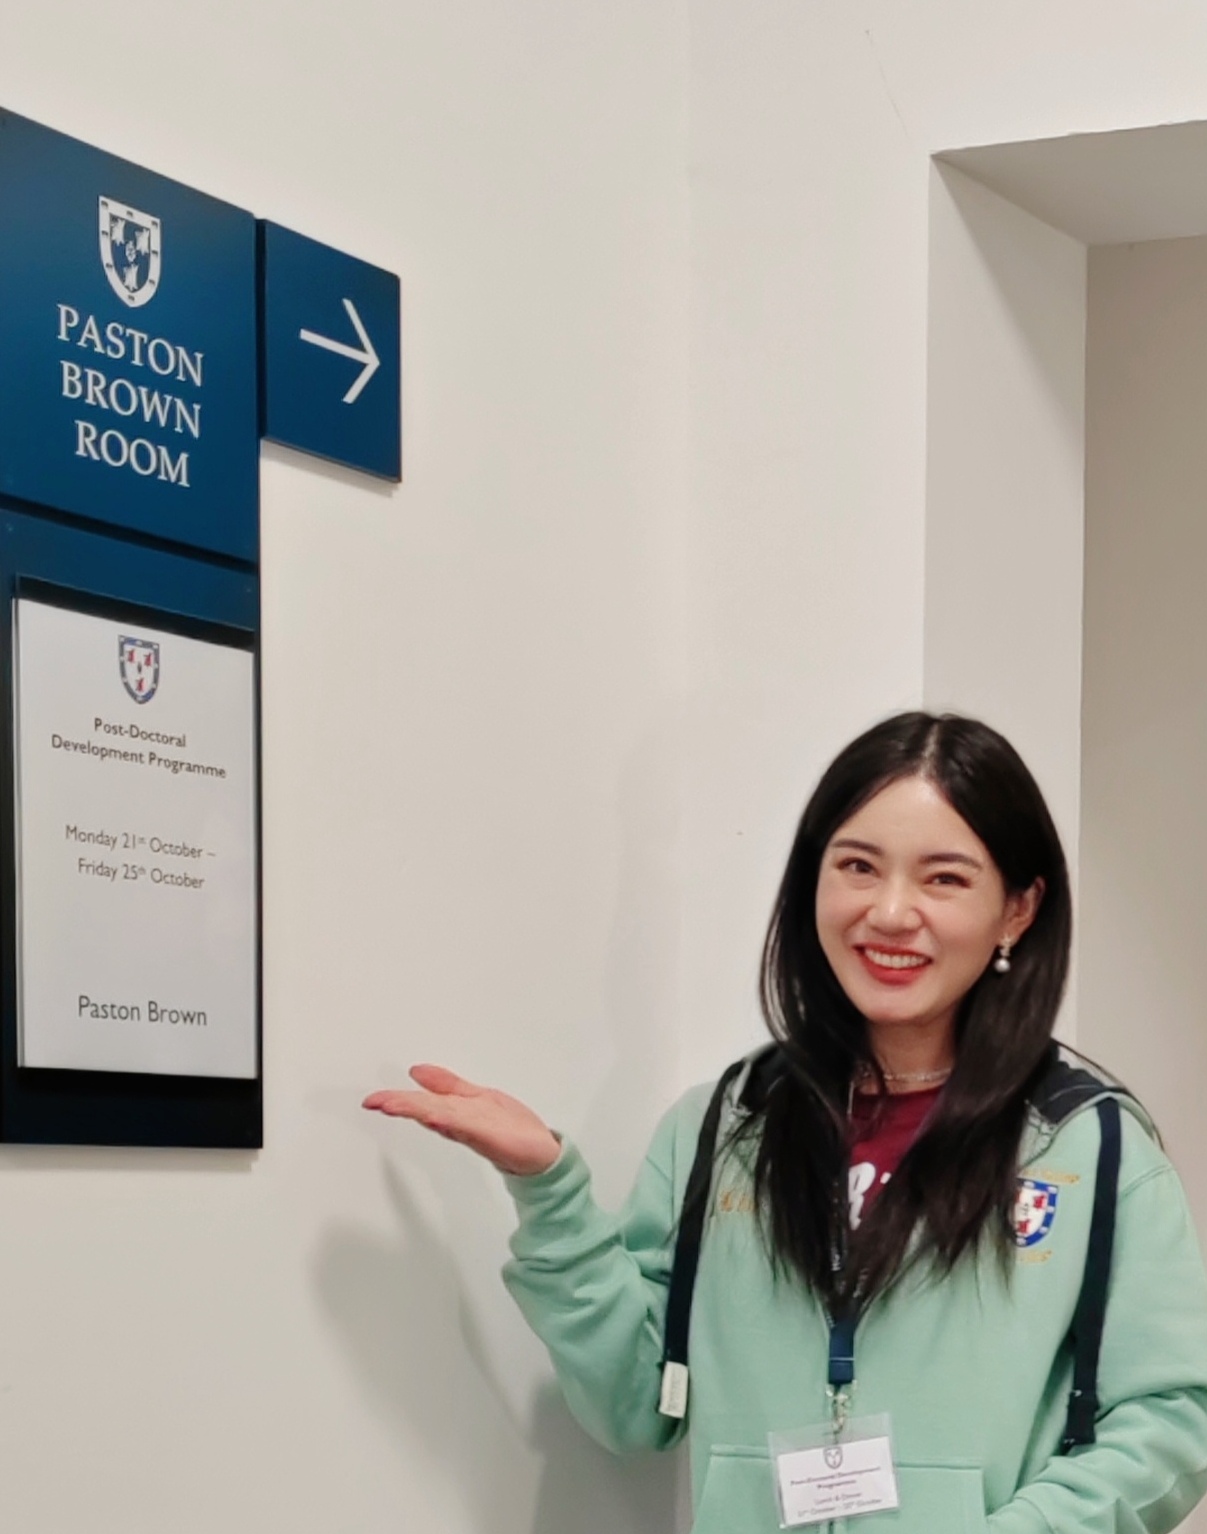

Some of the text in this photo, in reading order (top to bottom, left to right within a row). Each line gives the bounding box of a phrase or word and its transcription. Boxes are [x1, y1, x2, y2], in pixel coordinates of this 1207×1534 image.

[57, 303, 204, 388] PASTON
[60, 360, 201, 439] BROWN
[74, 419, 190, 488] ROOM
[94, 717, 187, 747] Post-Doctoral
[51, 733, 227, 779] Development Programme
[65, 824, 118, 851] Monday
[149, 837, 203, 859] October
[78, 858, 118, 882] Friday
[150, 867, 205, 889] October
[78, 995, 208, 1026] Paston Brown
